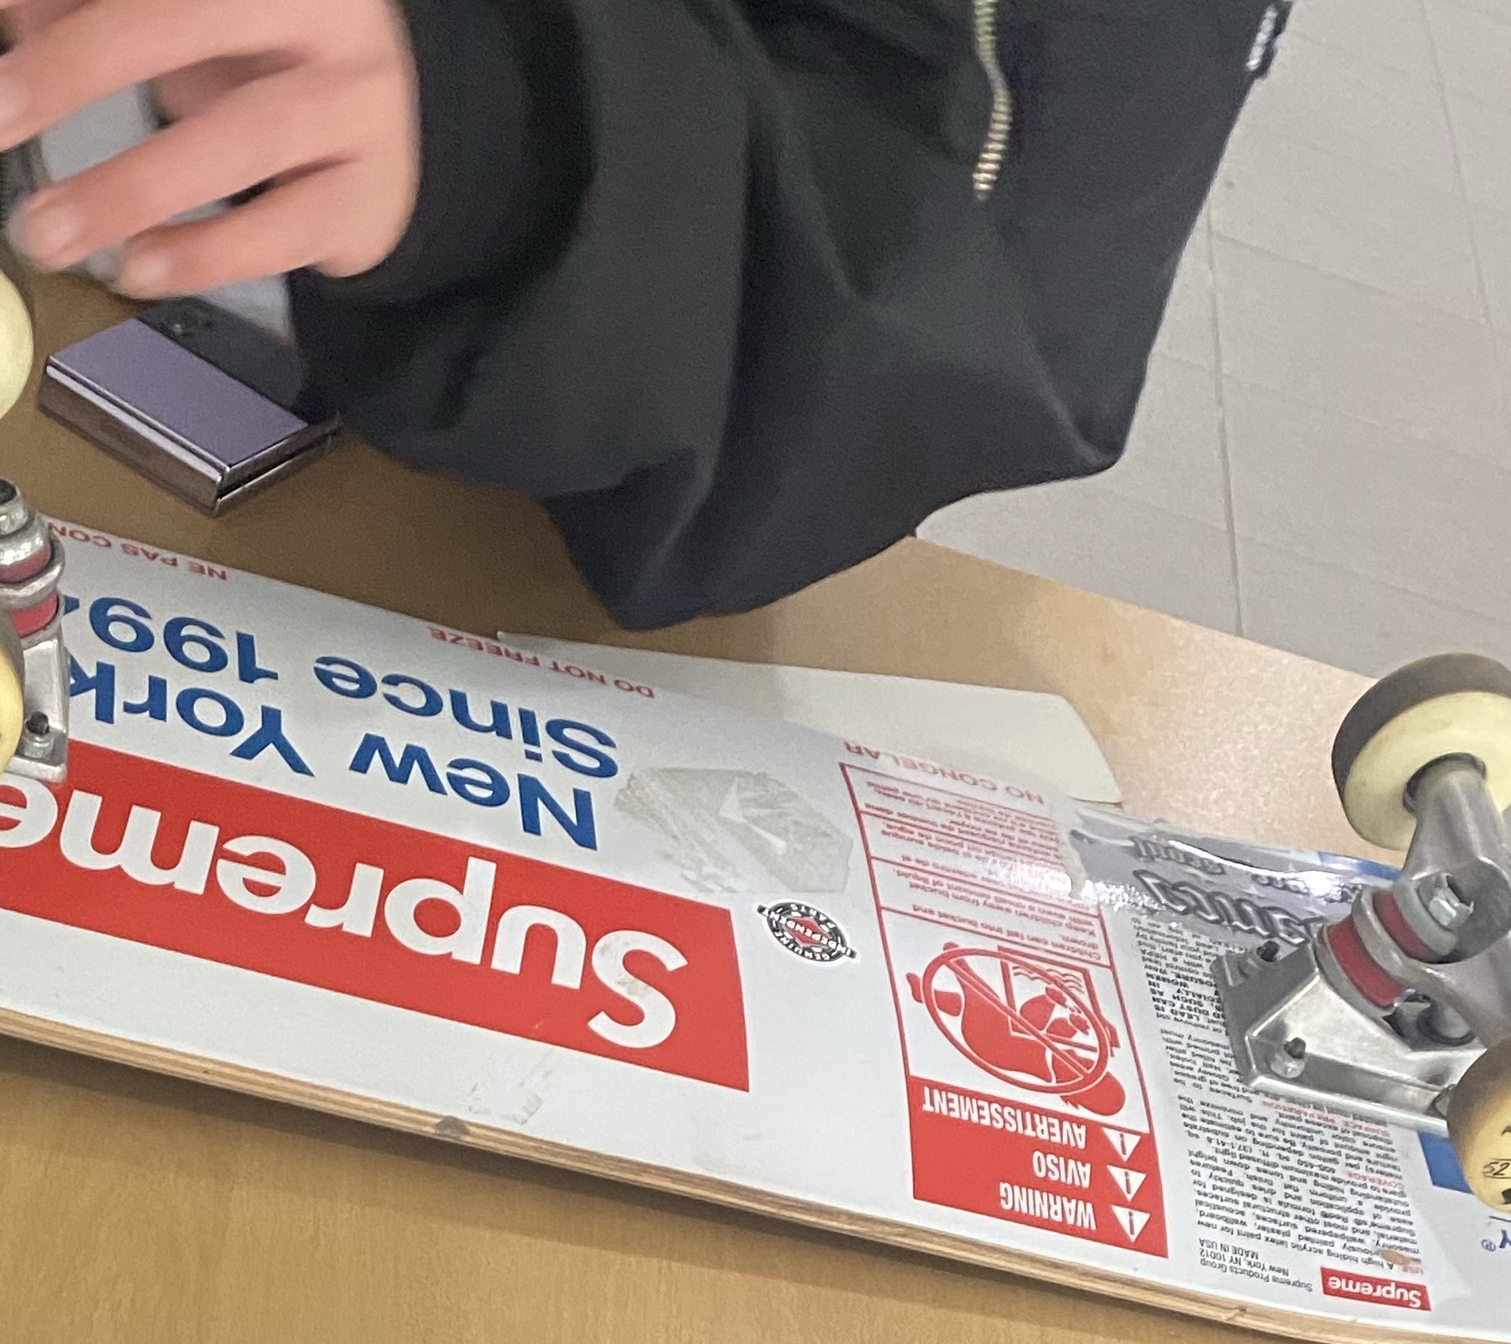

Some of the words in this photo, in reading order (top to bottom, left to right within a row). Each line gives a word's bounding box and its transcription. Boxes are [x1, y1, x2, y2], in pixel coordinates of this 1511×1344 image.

[119, 541, 180, 569] PAS
[190, 560, 229, 582] NE
[65, 596, 279, 684] 199
[430, 626, 543, 669] FREEZE
[545, 661, 609, 686] NOT
[613, 675, 656, 700] DO
[68, 656, 315, 777] York
[314, 655, 620, 779] Since
[842, 741, 998, 798] CONGELAR
[350, 732, 599, 852] New
[1005, 784, 1043, 804] NO
[922, 1086, 1086, 1149] AVERTISSEMENT
[1032, 1150, 1091, 1188] AVISO
[999, 1181, 1095, 1230] WARNING
[1198, 1237, 1217, 1248] USA
[1199, 1247, 1225, 1261] 10012
[1219, 1243, 1228, 1252] IN
[1231, 1246, 1258, 1259] MADE
[1200, 1257, 1226, 1272] Group
[1228, 1255, 1241, 1265] NY
[1268, 1264, 1288, 1276] New
[1229, 1265, 1269, 1282] Products
[1271, 1275, 1312, 1292] Supreme
[1327, 1275, 1421, 1307] Supreme
